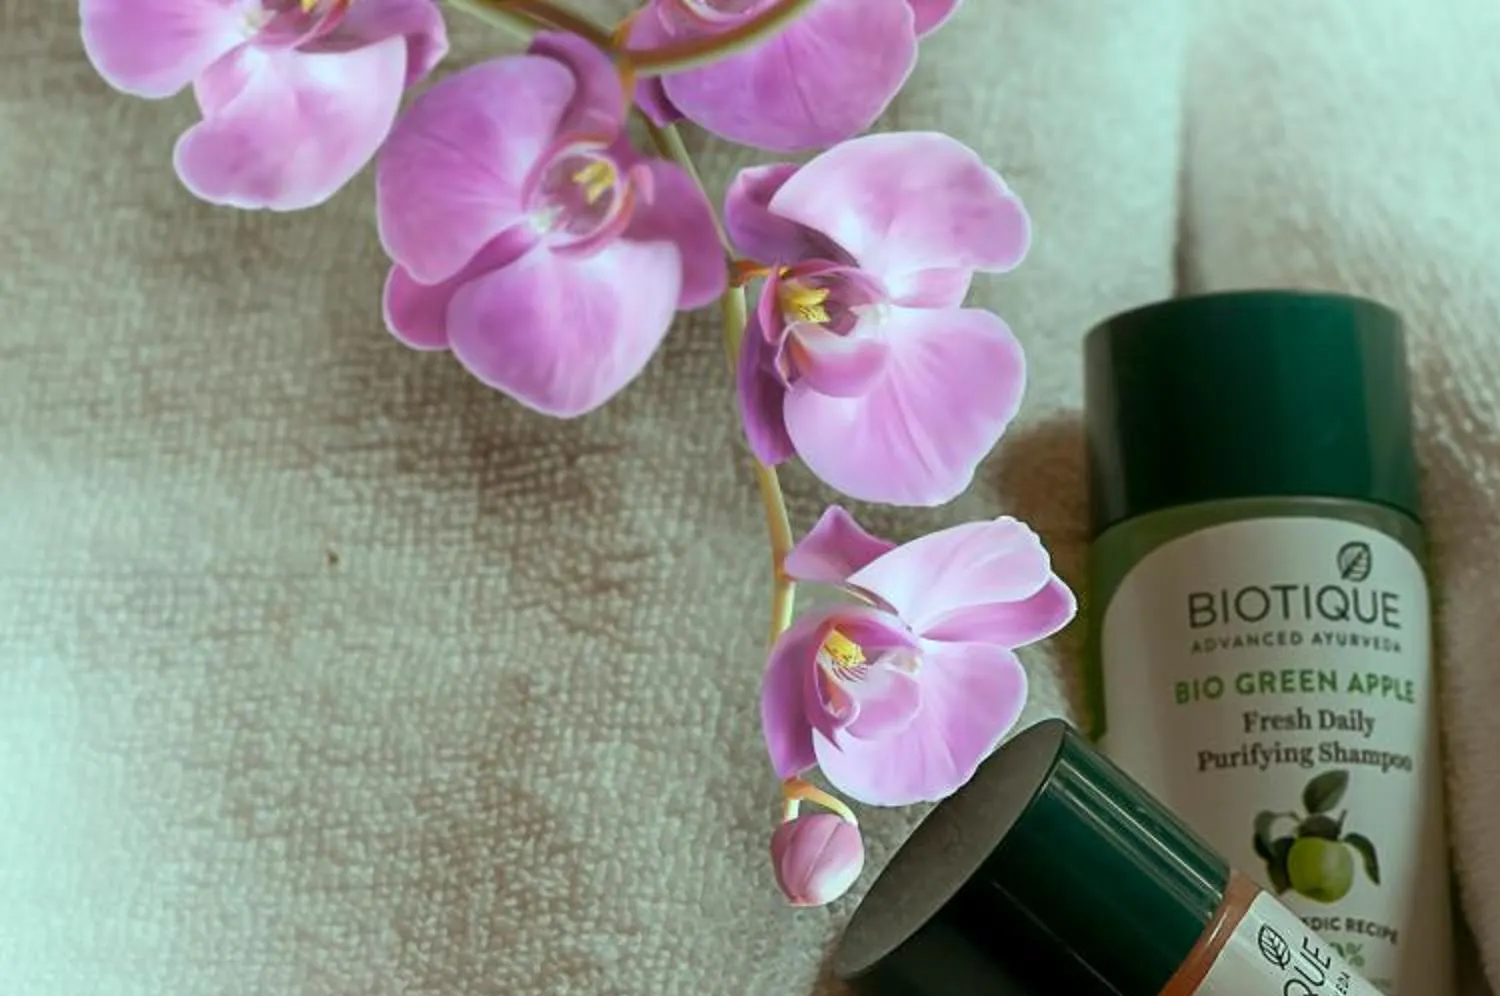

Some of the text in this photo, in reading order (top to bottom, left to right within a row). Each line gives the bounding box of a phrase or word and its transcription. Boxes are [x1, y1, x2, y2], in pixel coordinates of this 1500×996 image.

[1188, 584, 1402, 629] BIOTIQUE
[1192, 630, 1402, 654] ADVANCED AYURVEDA
[1175, 670, 1416, 704] BIO GREEN APPLE
[1243, 707, 1376, 737] Fresh Daily
[1198, 742, 1412, 774] Purifying Shampoo
